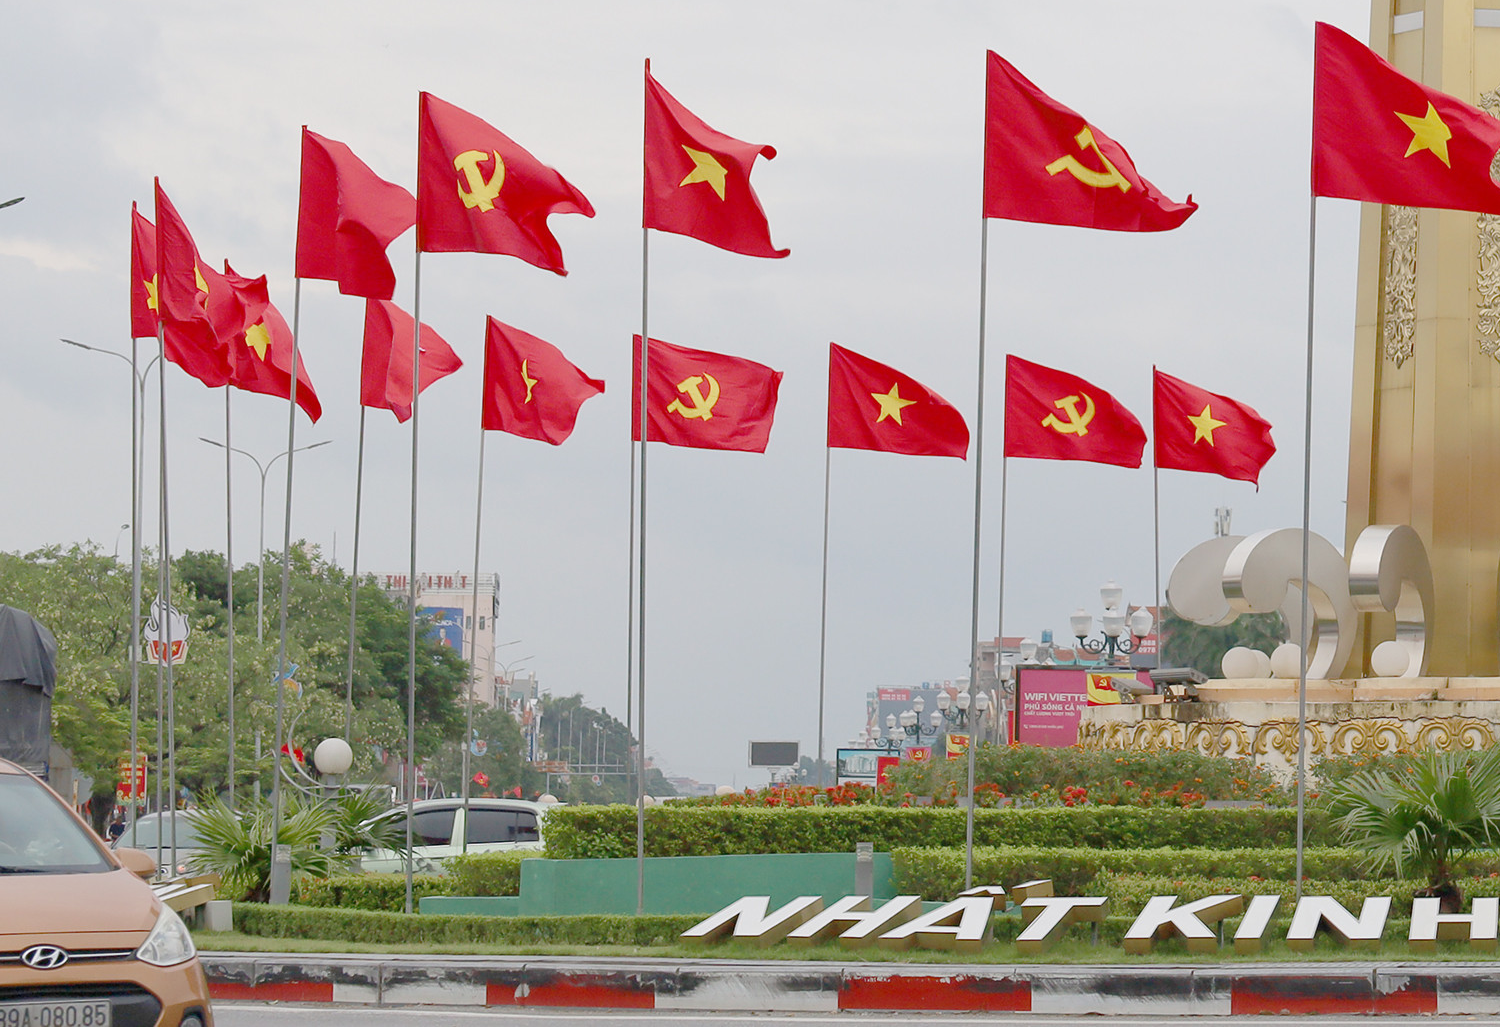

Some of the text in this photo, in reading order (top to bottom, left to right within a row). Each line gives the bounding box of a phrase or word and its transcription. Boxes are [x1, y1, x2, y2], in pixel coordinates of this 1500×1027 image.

[1024, 692, 1087, 702] WIFI VIETTE
[679, 879, 1109, 947] NHẤT
[1123, 895, 1500, 948] KINH
